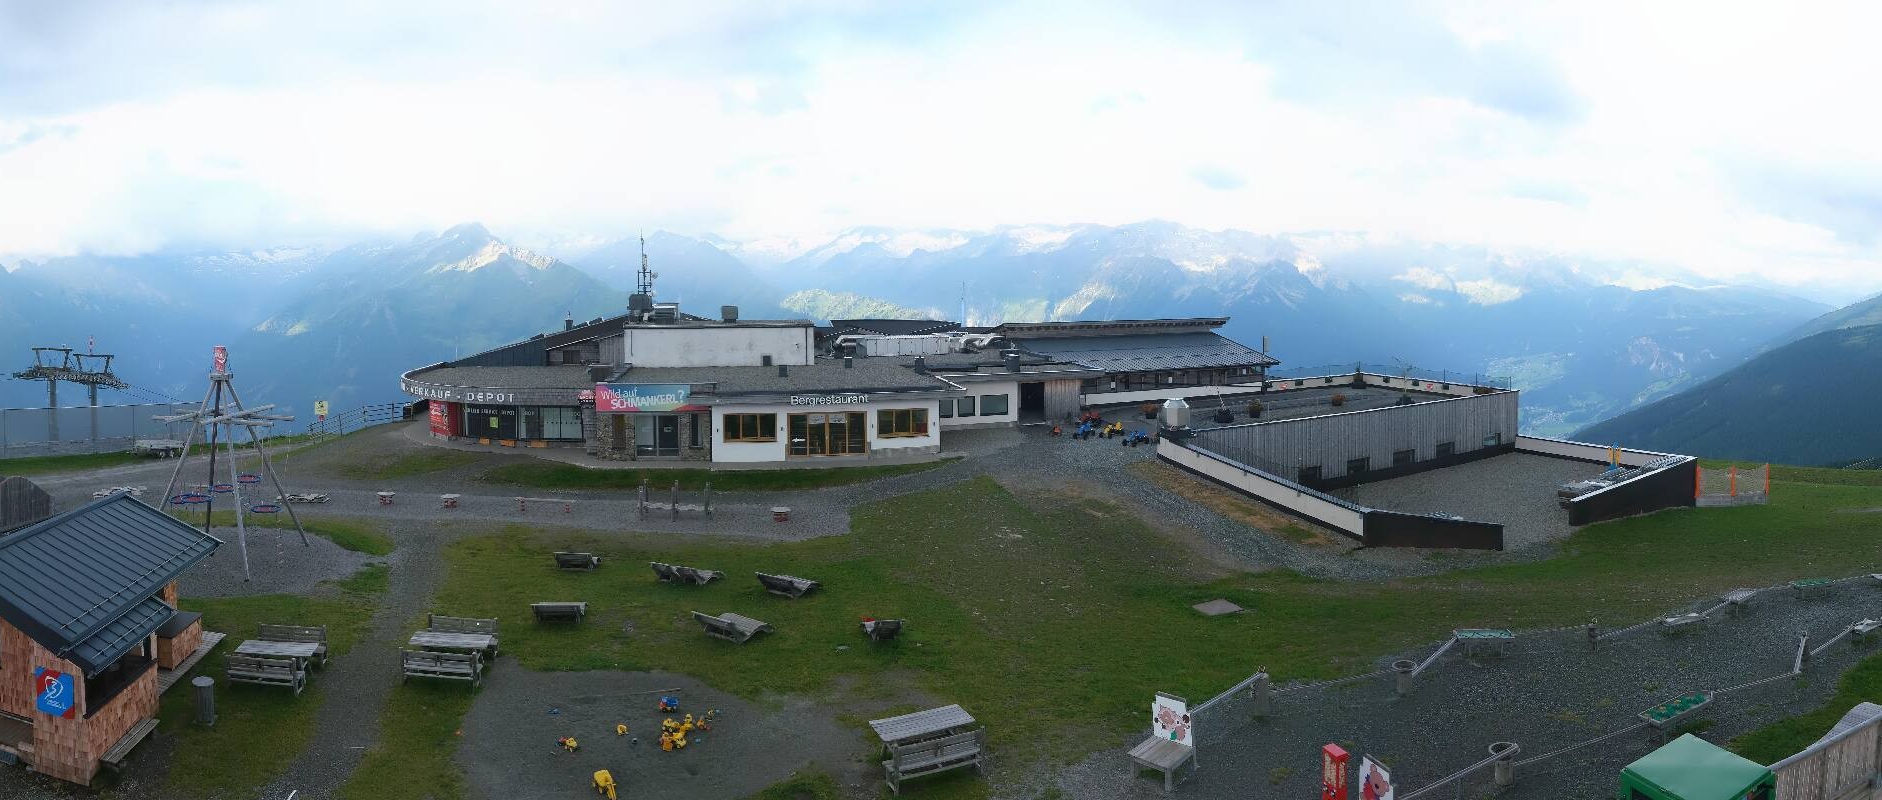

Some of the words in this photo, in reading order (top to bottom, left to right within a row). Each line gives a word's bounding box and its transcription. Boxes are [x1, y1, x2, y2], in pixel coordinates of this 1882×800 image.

[410, 386, 451, 399] VERKAUF
[467, 391, 515, 403] DEPOT
[601, 388, 621, 400] Wild
[623, 386, 638, 398] auf
[790, 394, 869, 407] Bergrestaurant
